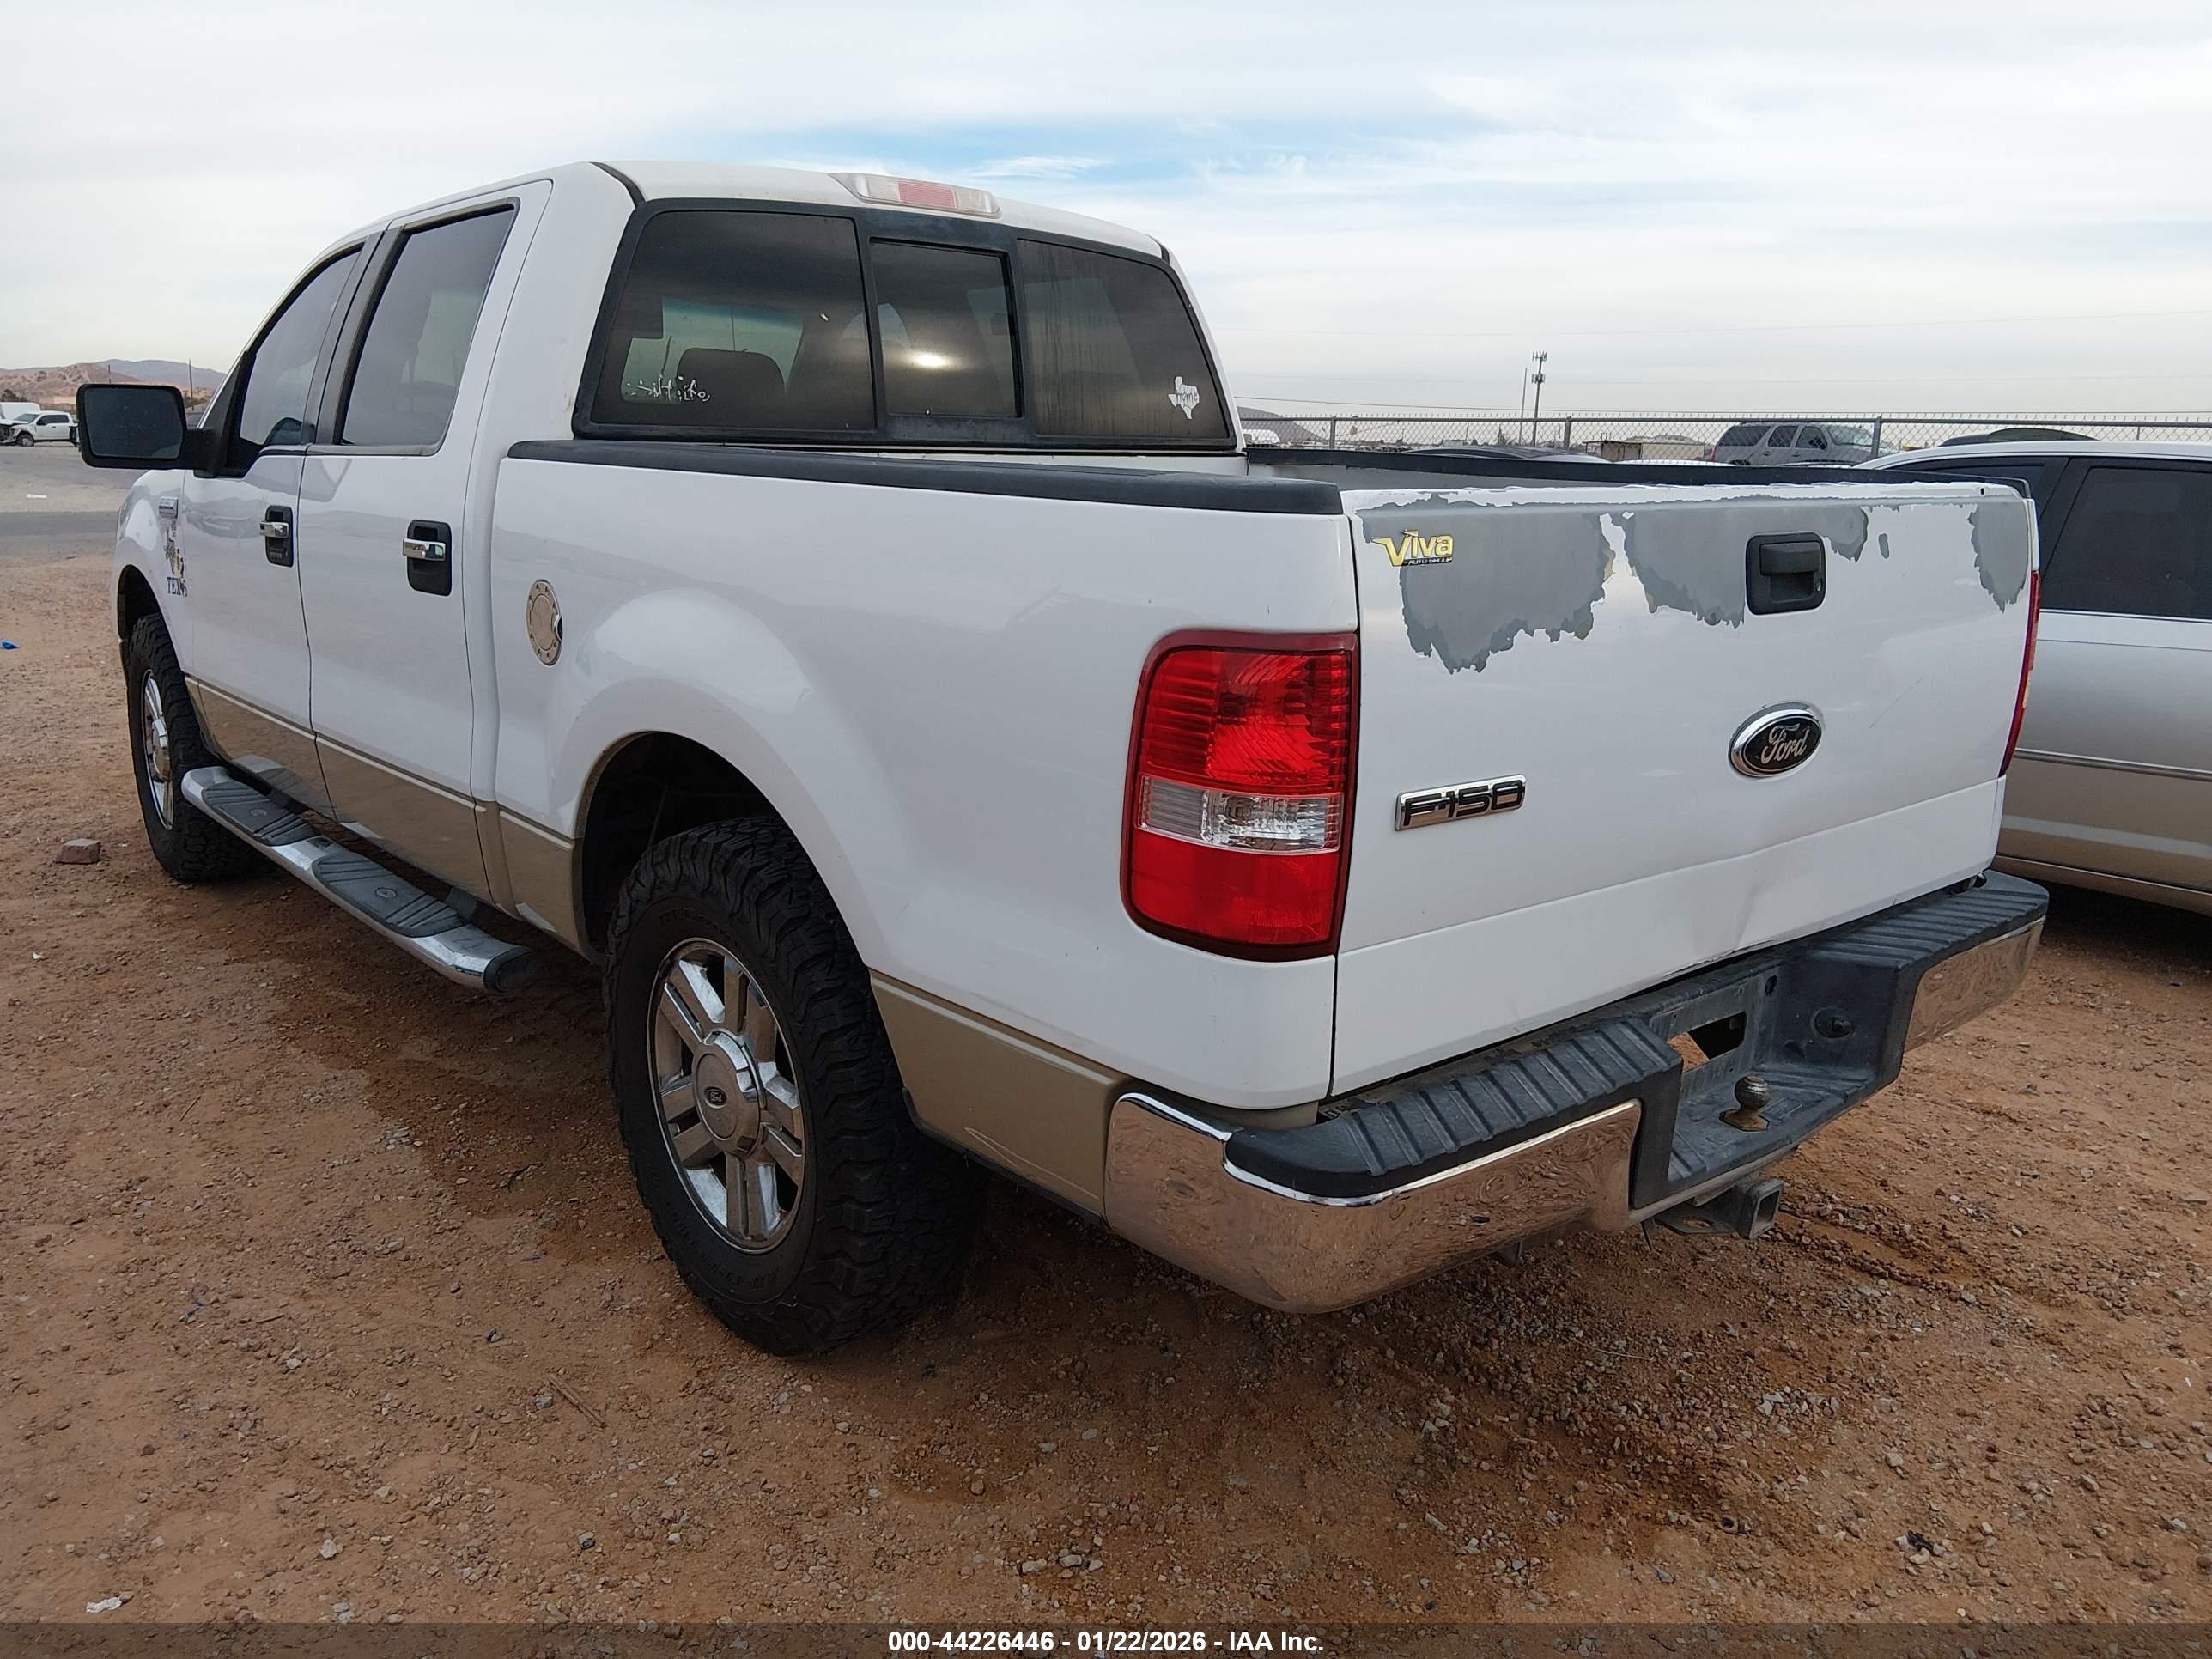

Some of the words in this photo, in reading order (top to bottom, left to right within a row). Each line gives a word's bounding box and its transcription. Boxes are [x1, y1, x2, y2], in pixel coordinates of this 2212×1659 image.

[1371, 529, 1455, 567] Viva
[1760, 722, 1811, 764] Ford
[1402, 779, 1523, 826] F-150
